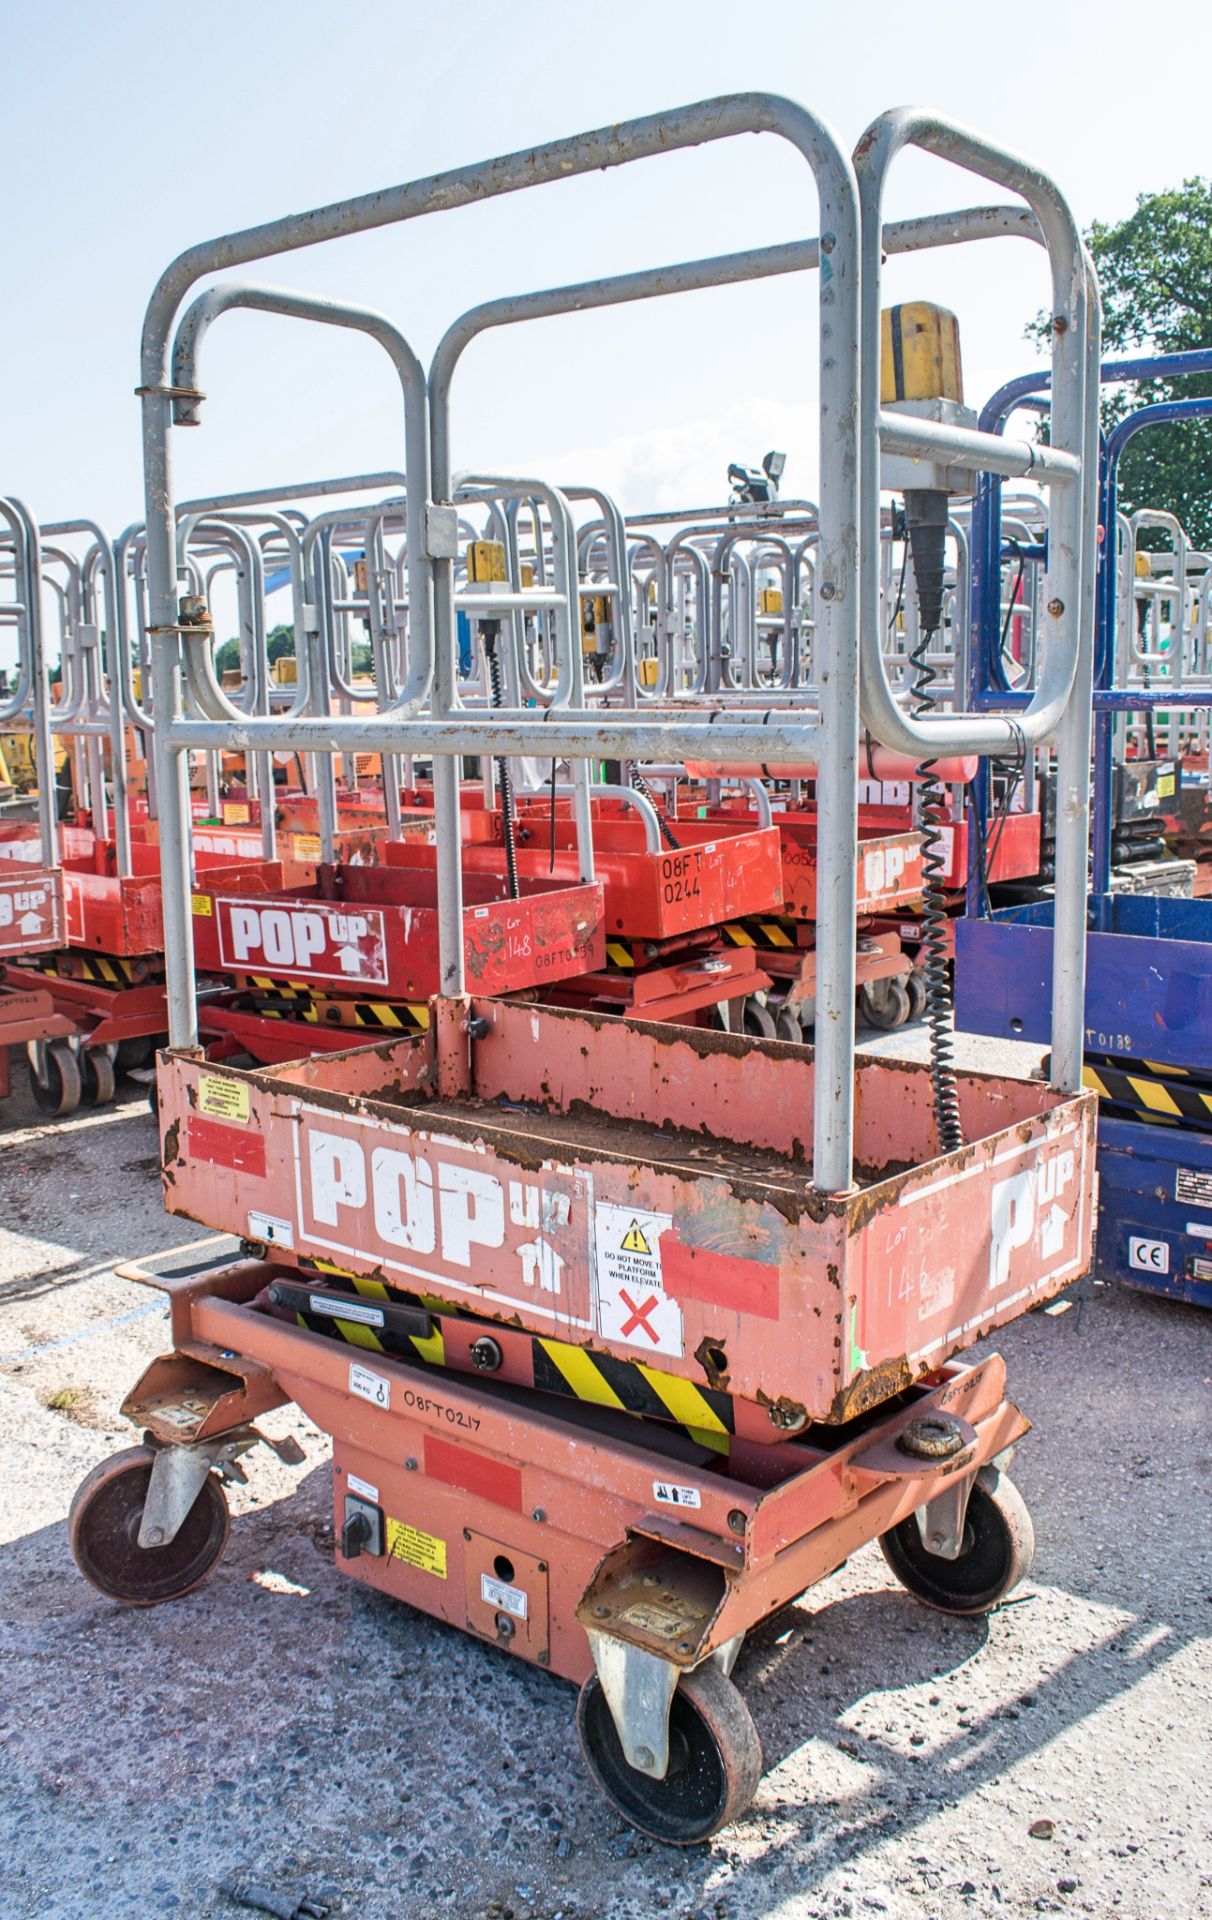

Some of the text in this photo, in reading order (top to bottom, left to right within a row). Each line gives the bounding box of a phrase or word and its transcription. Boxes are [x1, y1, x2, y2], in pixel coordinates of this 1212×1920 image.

[662, 852, 702, 879] 08FT
[664, 877, 700, 904] 0244
[229, 907, 368, 968] POP UP
[508, 934, 532, 958] 148
[1037, 1149, 1074, 1207] UP
[308, 1129, 504, 1267] POP
[604, 1251, 616, 1260] DO
[616, 1254, 631, 1264] NOT
[633, 1257, 654, 1269] MOVE
[618, 1263, 657, 1278] PLATFORM
[608, 1270, 630, 1281] WHEN
[403, 1390, 481, 1431] 08FT0217
